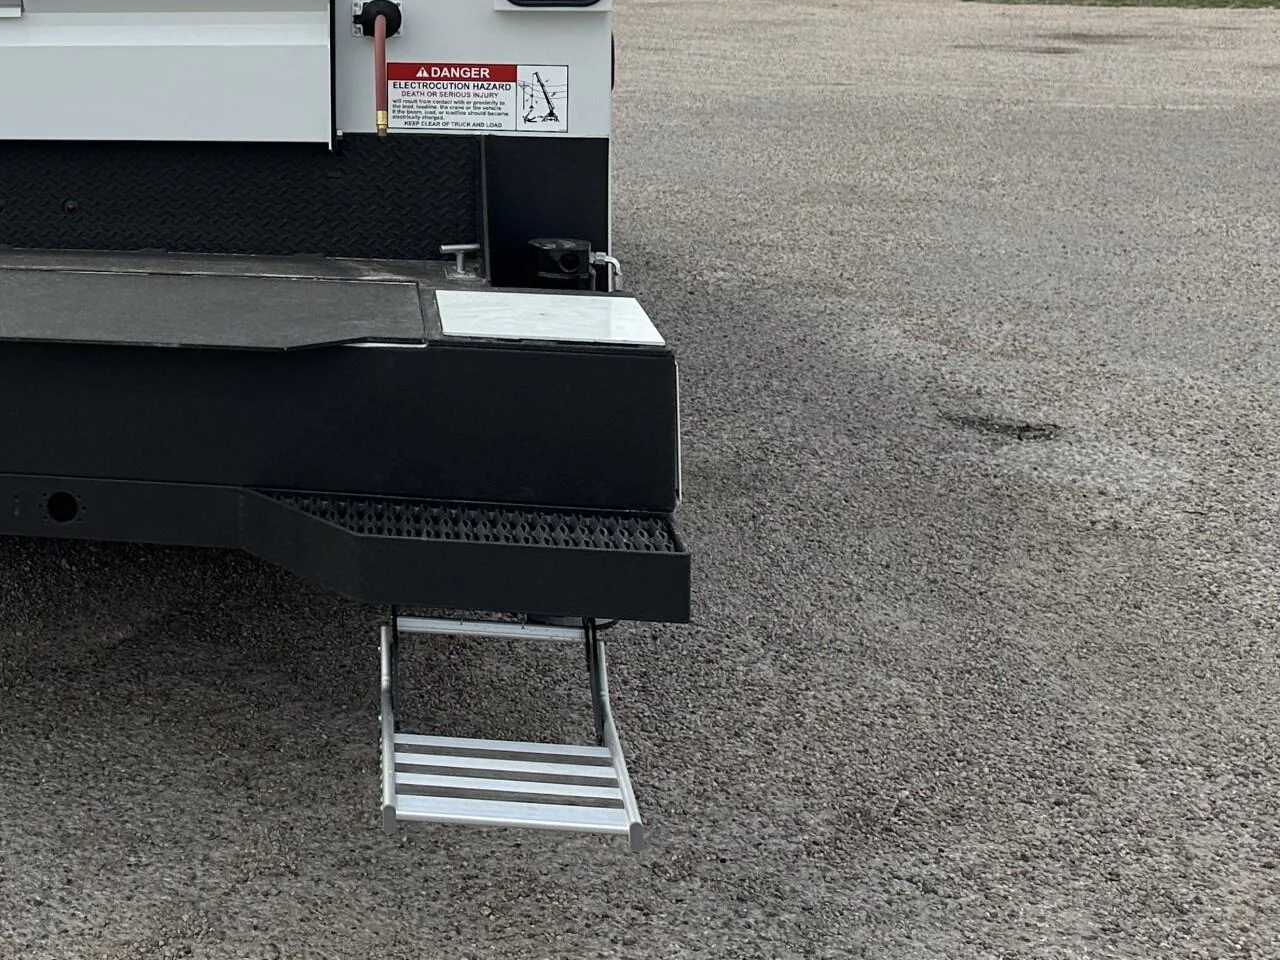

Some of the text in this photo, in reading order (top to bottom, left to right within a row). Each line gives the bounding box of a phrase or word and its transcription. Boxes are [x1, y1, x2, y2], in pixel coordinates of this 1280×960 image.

[431, 67, 490, 78] DANGER
[393, 82, 512, 91] ELECTROCUTION HAZARD
